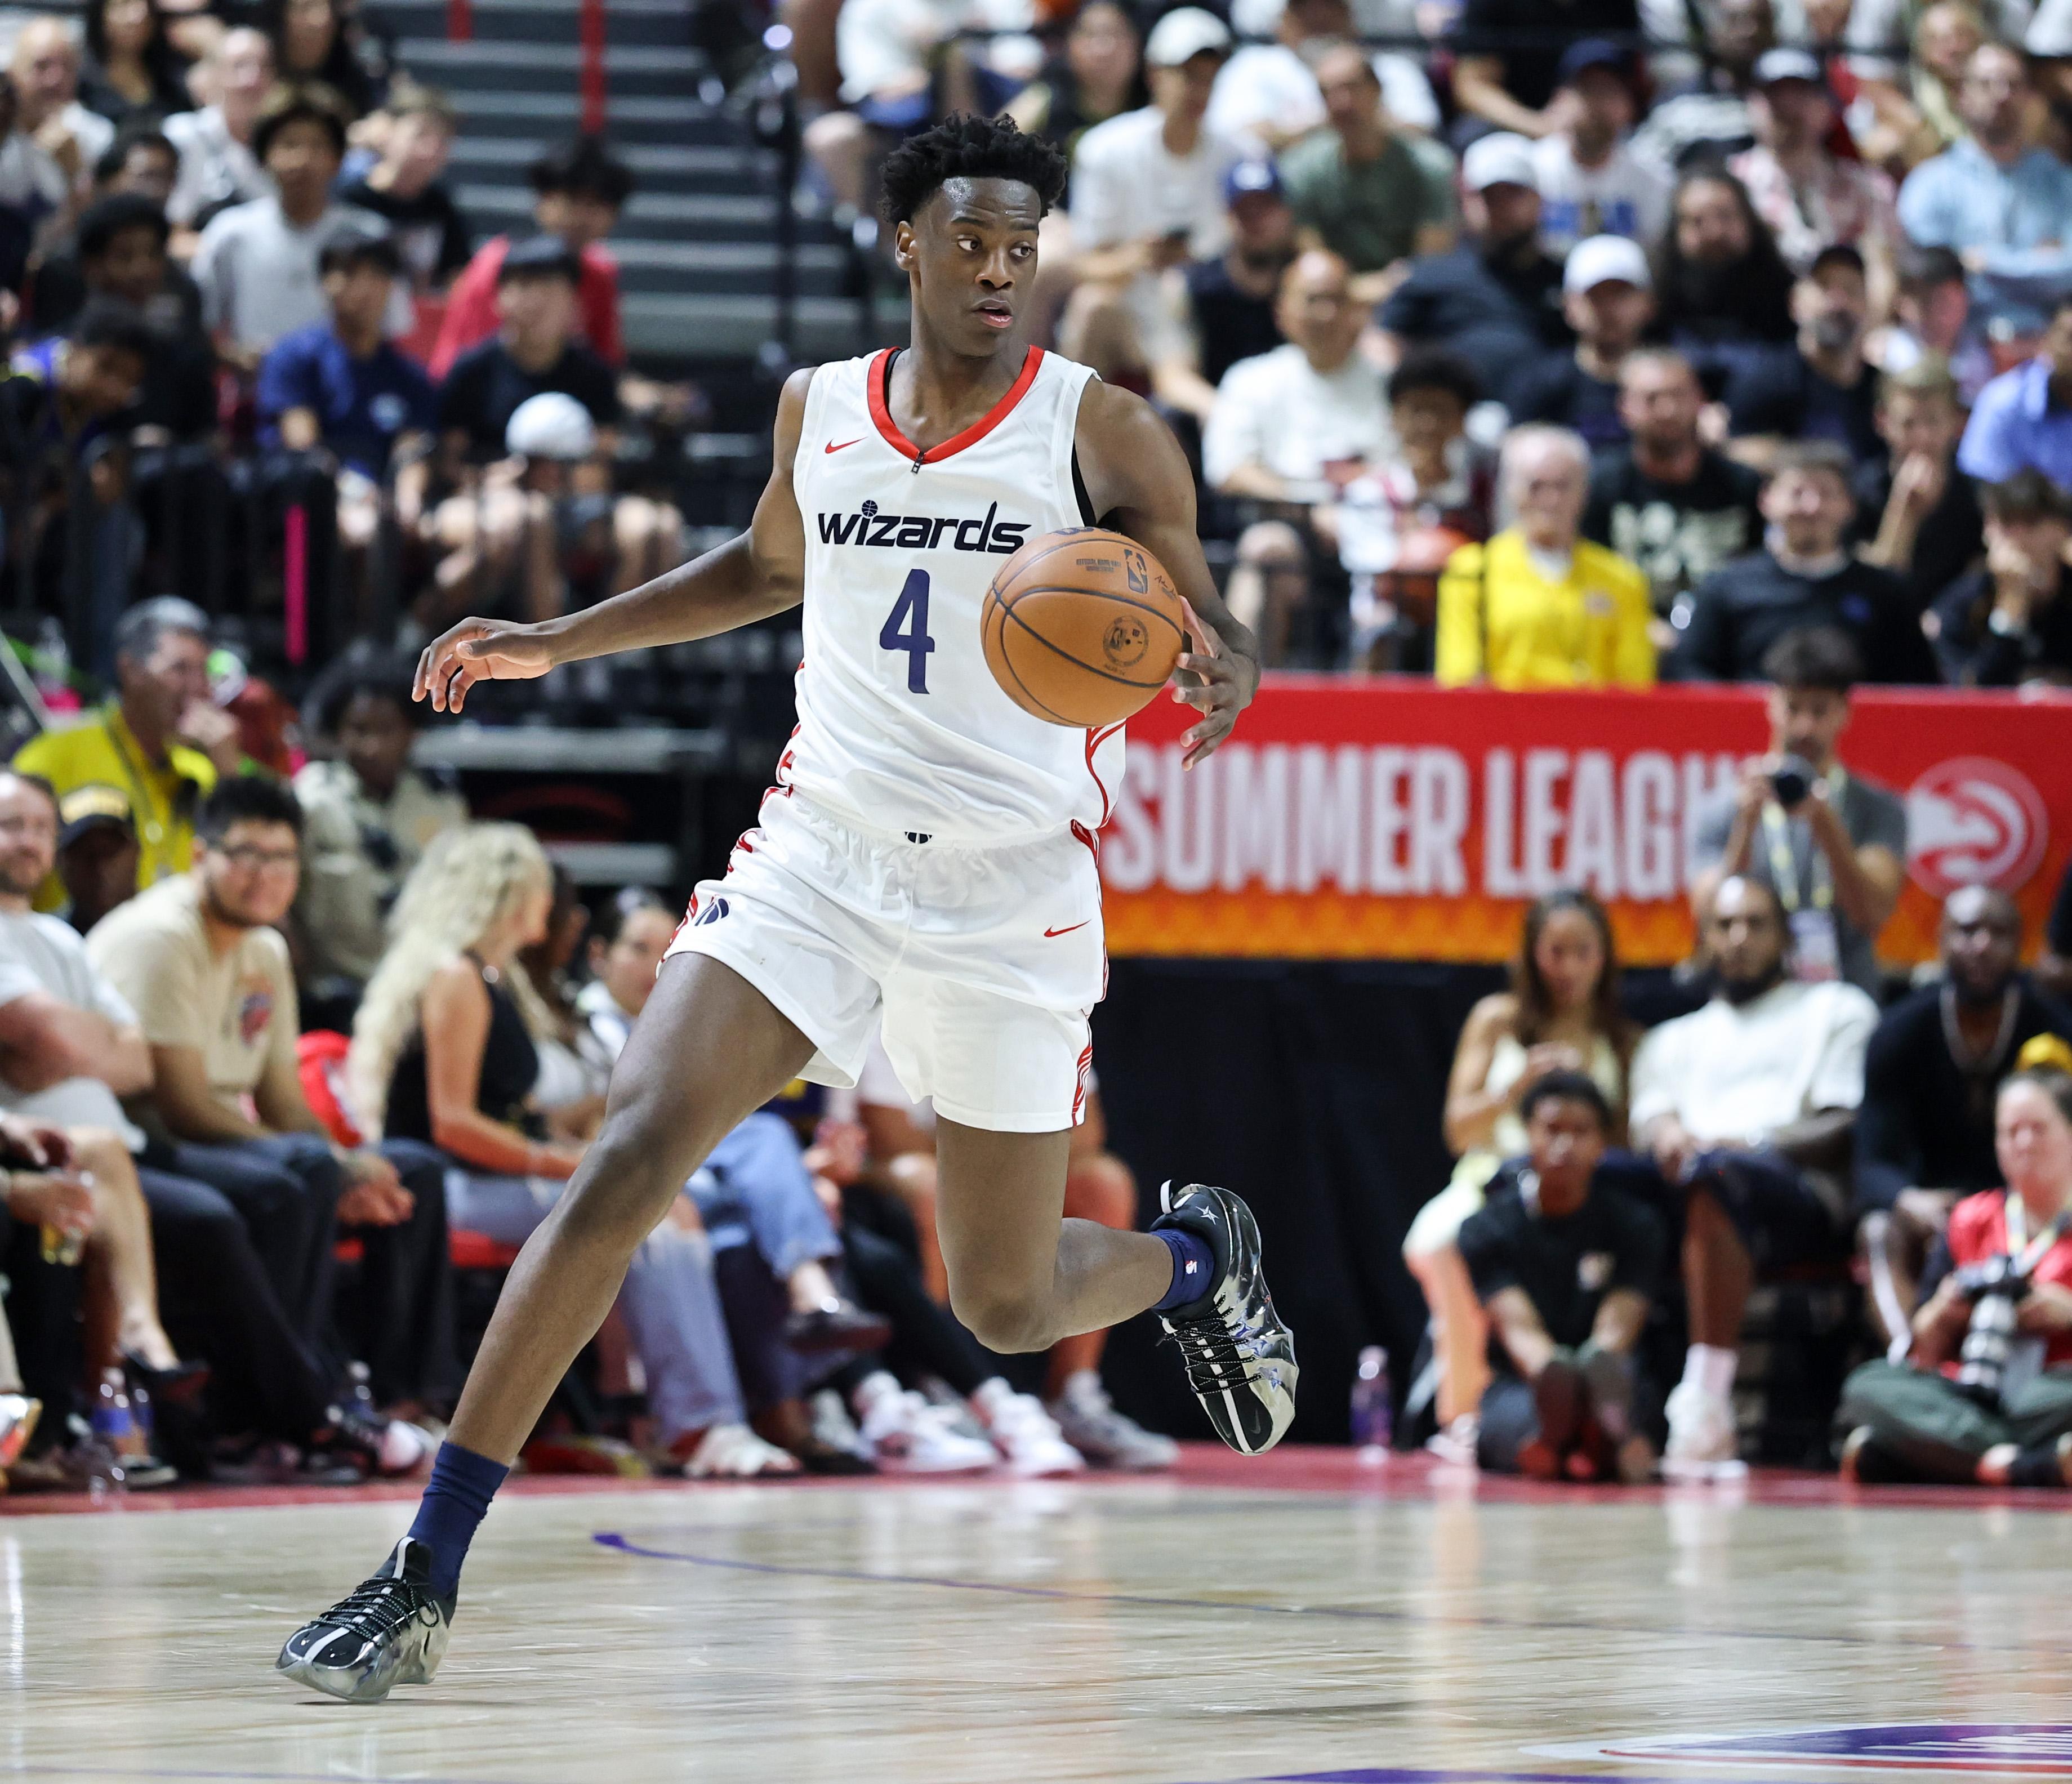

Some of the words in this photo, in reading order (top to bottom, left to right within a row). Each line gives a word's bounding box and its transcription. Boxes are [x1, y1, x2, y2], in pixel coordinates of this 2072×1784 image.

[818, 499, 1032, 554] wizards
[880, 569, 935, 694] 4
[1104, 743, 1468, 898] SUMMER
